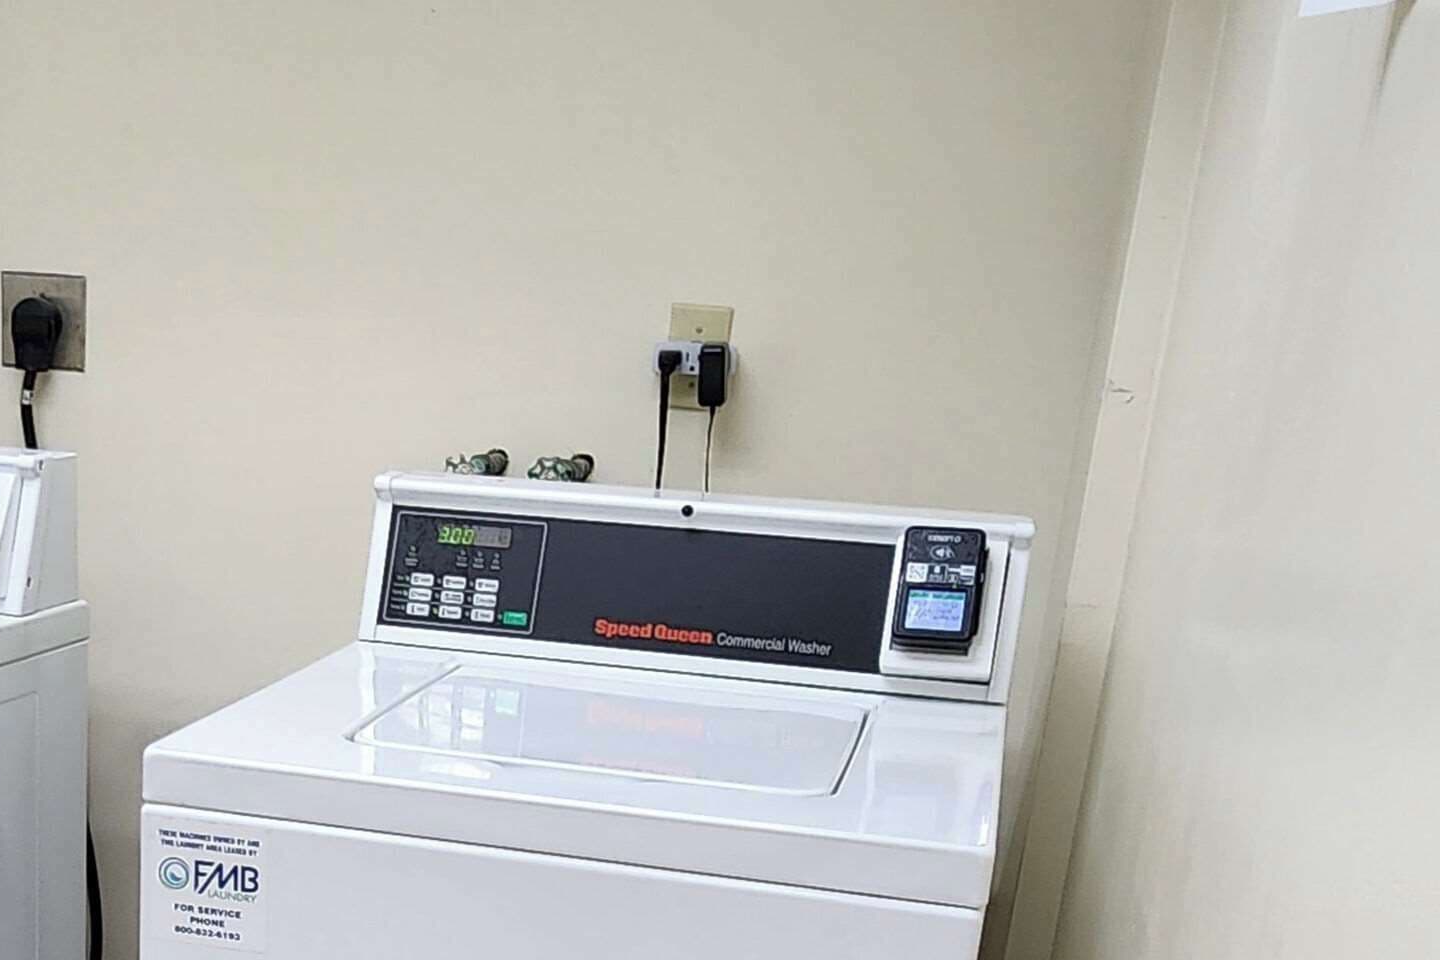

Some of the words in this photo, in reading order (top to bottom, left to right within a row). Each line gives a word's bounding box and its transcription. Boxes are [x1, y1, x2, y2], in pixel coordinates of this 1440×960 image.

[594, 618, 652, 638] Speed
[654, 623, 713, 645] Queen
[716, 631, 785, 651] Commercial
[787, 639, 833, 656] Washer
[193, 859, 260, 894] FMB
[207, 889, 258, 904] LAUNDRY
[174, 903, 195, 913] FOR
[198, 906, 242, 919] SERVICE
[190, 916, 226, 928] PHONE
